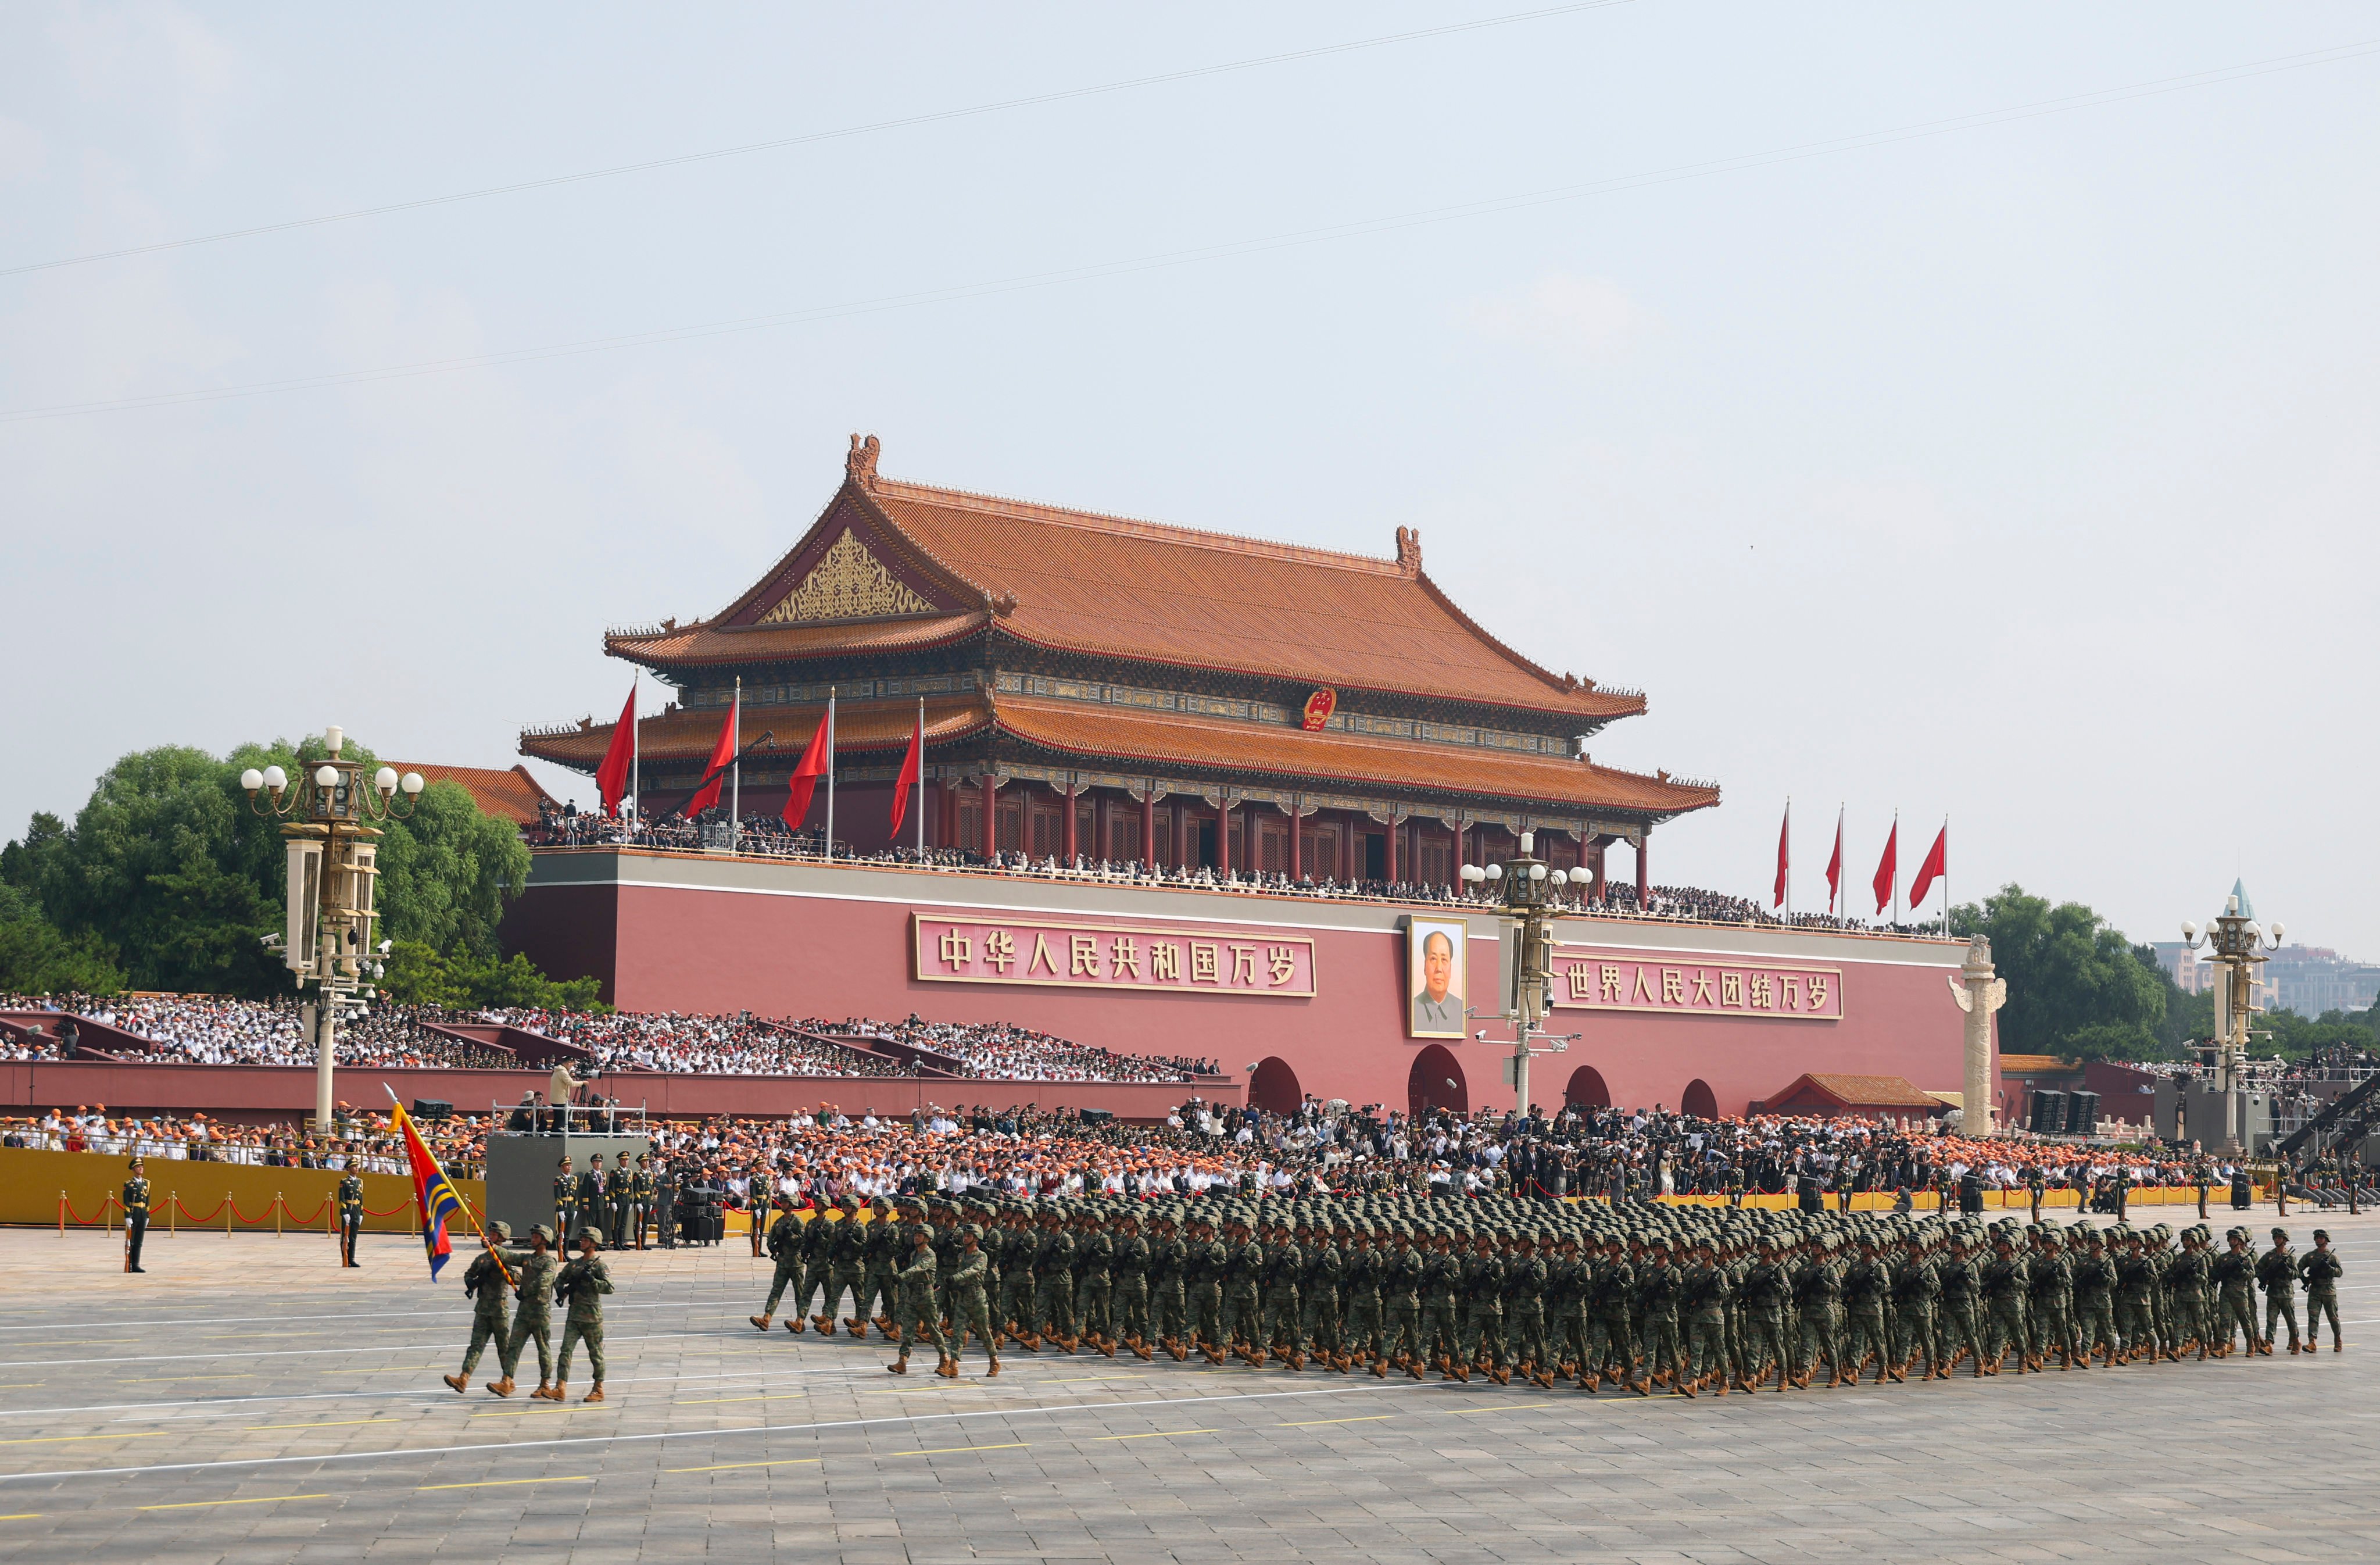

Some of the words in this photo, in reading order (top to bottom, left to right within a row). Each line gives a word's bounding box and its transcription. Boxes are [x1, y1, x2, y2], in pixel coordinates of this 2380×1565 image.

[939, 928, 1297, 985] 中华人民共和国万岁
[1567, 963, 1828, 1010] 世界人民大团结万岁
